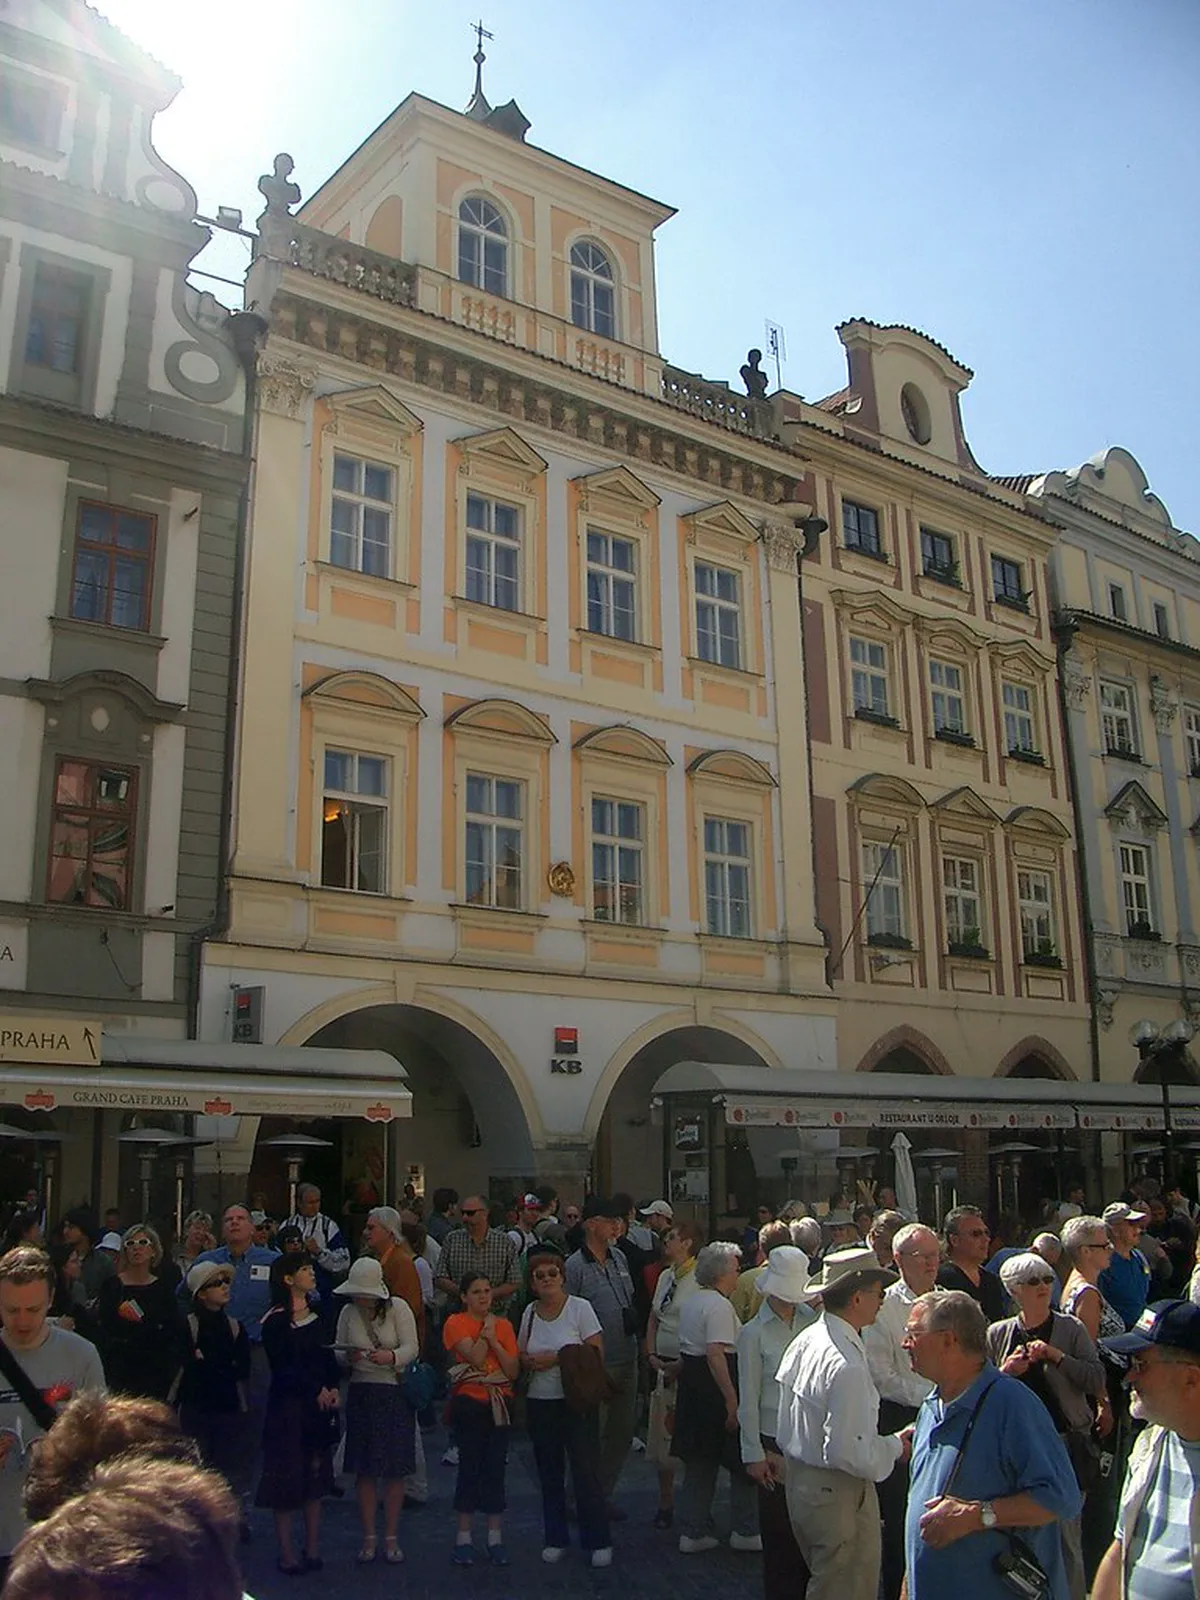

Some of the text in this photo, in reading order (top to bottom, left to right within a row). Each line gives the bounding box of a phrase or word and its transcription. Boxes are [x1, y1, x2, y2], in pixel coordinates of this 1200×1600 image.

[234, 1023, 253, 1039] KB
[0, 1030, 71, 1051] PRAHA
[550, 1059, 583, 1075] KB
[73, 1091, 118, 1103] GRAND
[150, 1096, 189, 1107] PRAHA
[879, 1113, 926, 1124] RESTAURANT
